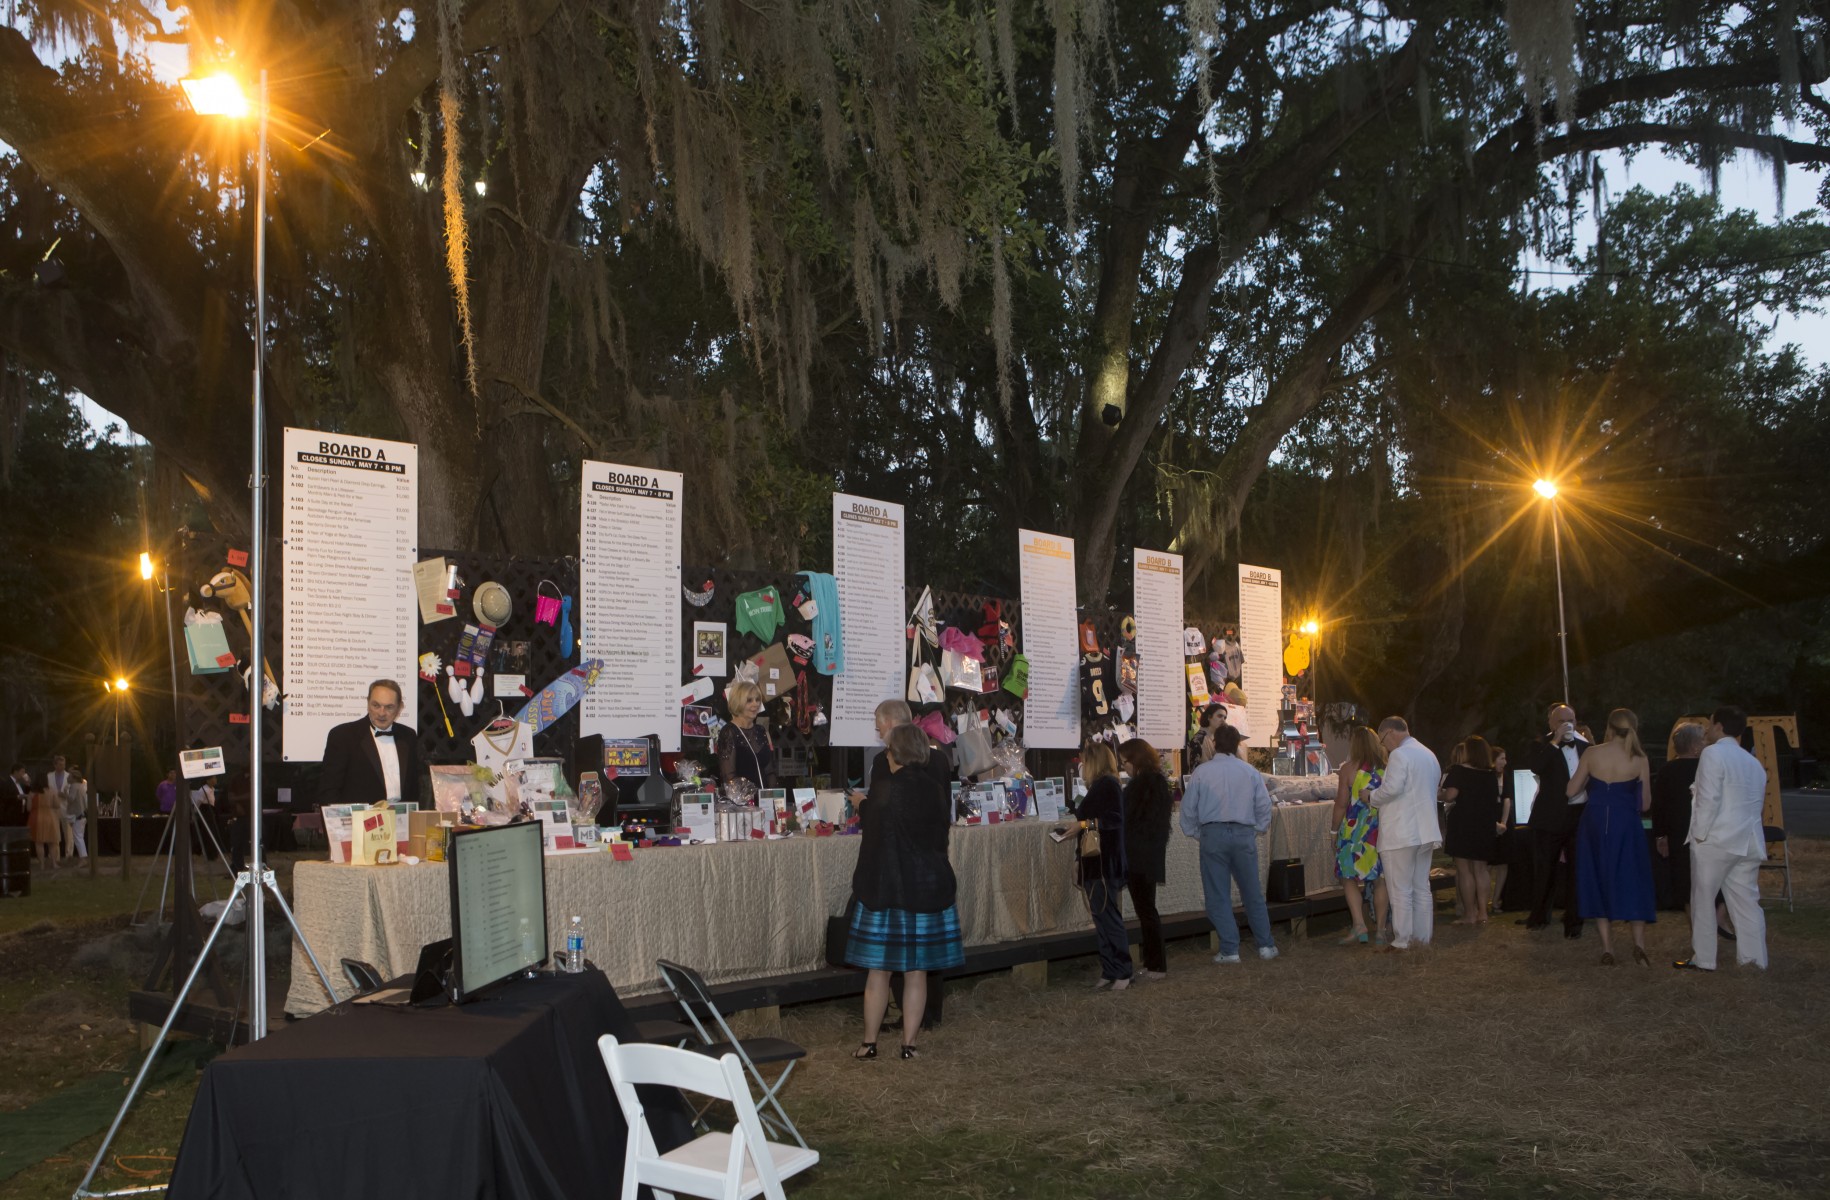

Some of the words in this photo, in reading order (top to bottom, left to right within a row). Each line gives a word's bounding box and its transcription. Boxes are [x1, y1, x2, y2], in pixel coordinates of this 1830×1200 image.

[319, 442, 371, 458] BOARD
[376, 449, 386, 461] A
[302, 455, 327, 463] CLOSES
[329, 458, 357, 468] SUNDAY,
[308, 467, 337, 475] Description
[609, 472, 648, 486] BOARD
[651, 478, 659, 488] A
[616, 486, 637, 495] SUNDAY,
[852, 503, 880, 516] BOARD
[883, 509, 888, 518] A
[1147, 556, 1166, 565] BOARD
[1250, 571, 1266, 579] BOARD
[1092, 679, 1108, 715] 9
[541, 690, 558, 721] Surf
